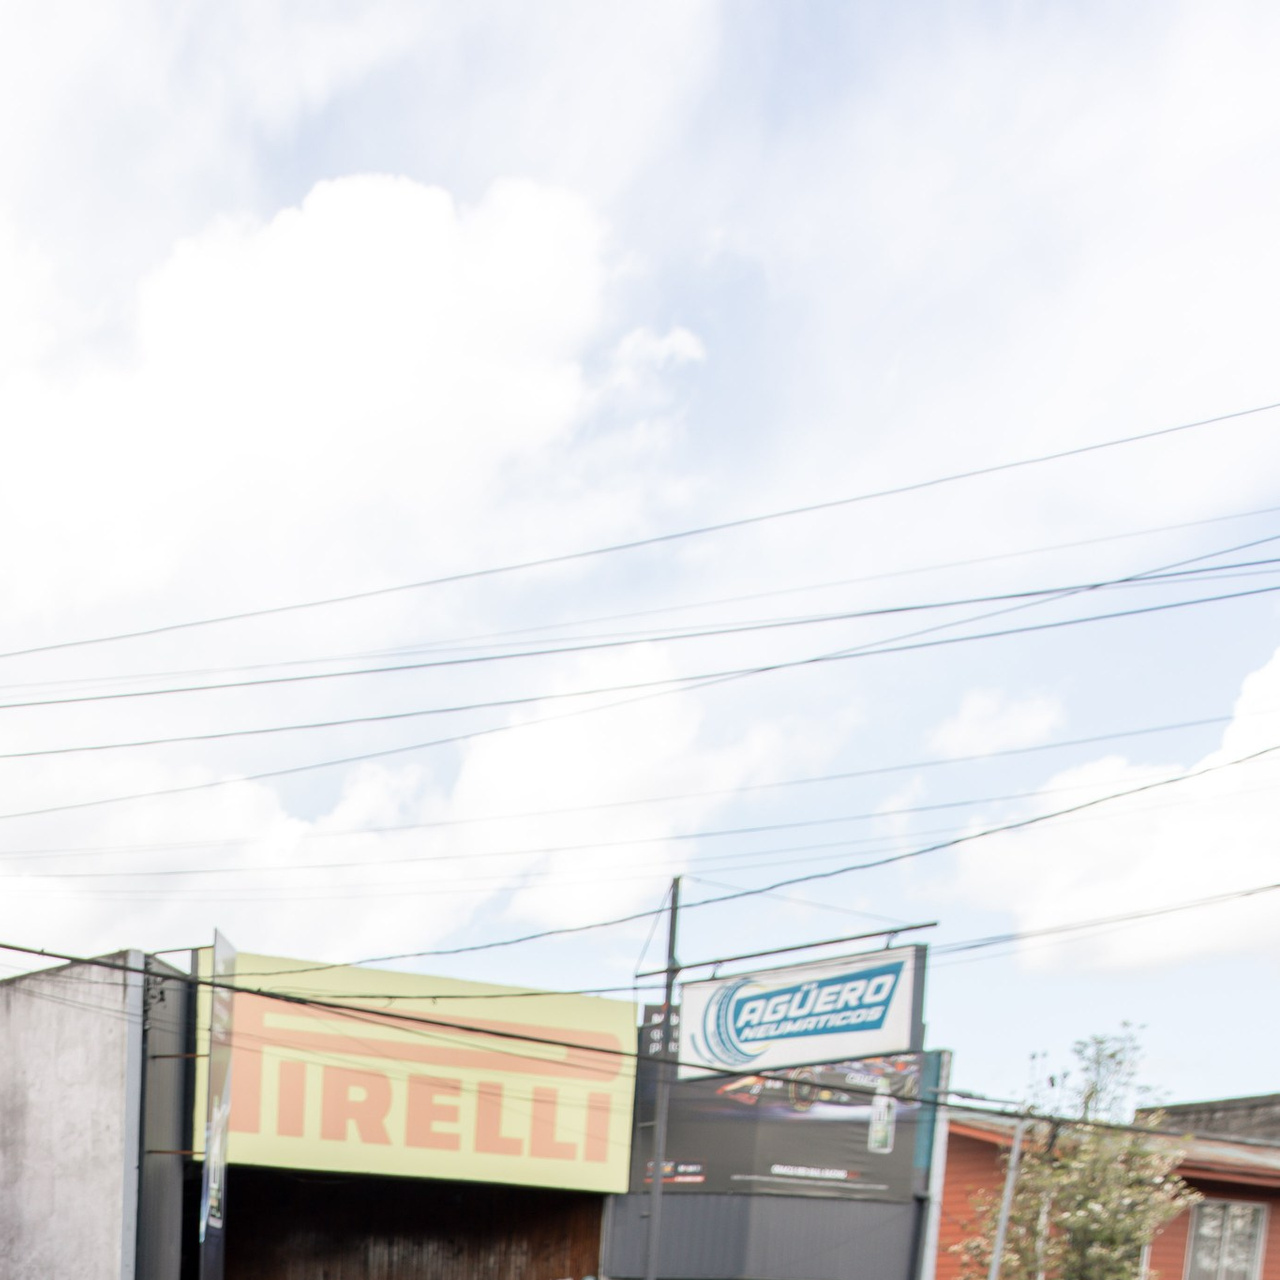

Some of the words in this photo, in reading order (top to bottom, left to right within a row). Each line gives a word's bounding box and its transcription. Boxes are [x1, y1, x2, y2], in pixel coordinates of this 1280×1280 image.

[736, 973, 896, 1028] AGÜERO
[740, 1006, 885, 1041] NEUMATICOS
[226, 990, 622, 1164] PIRELLI
